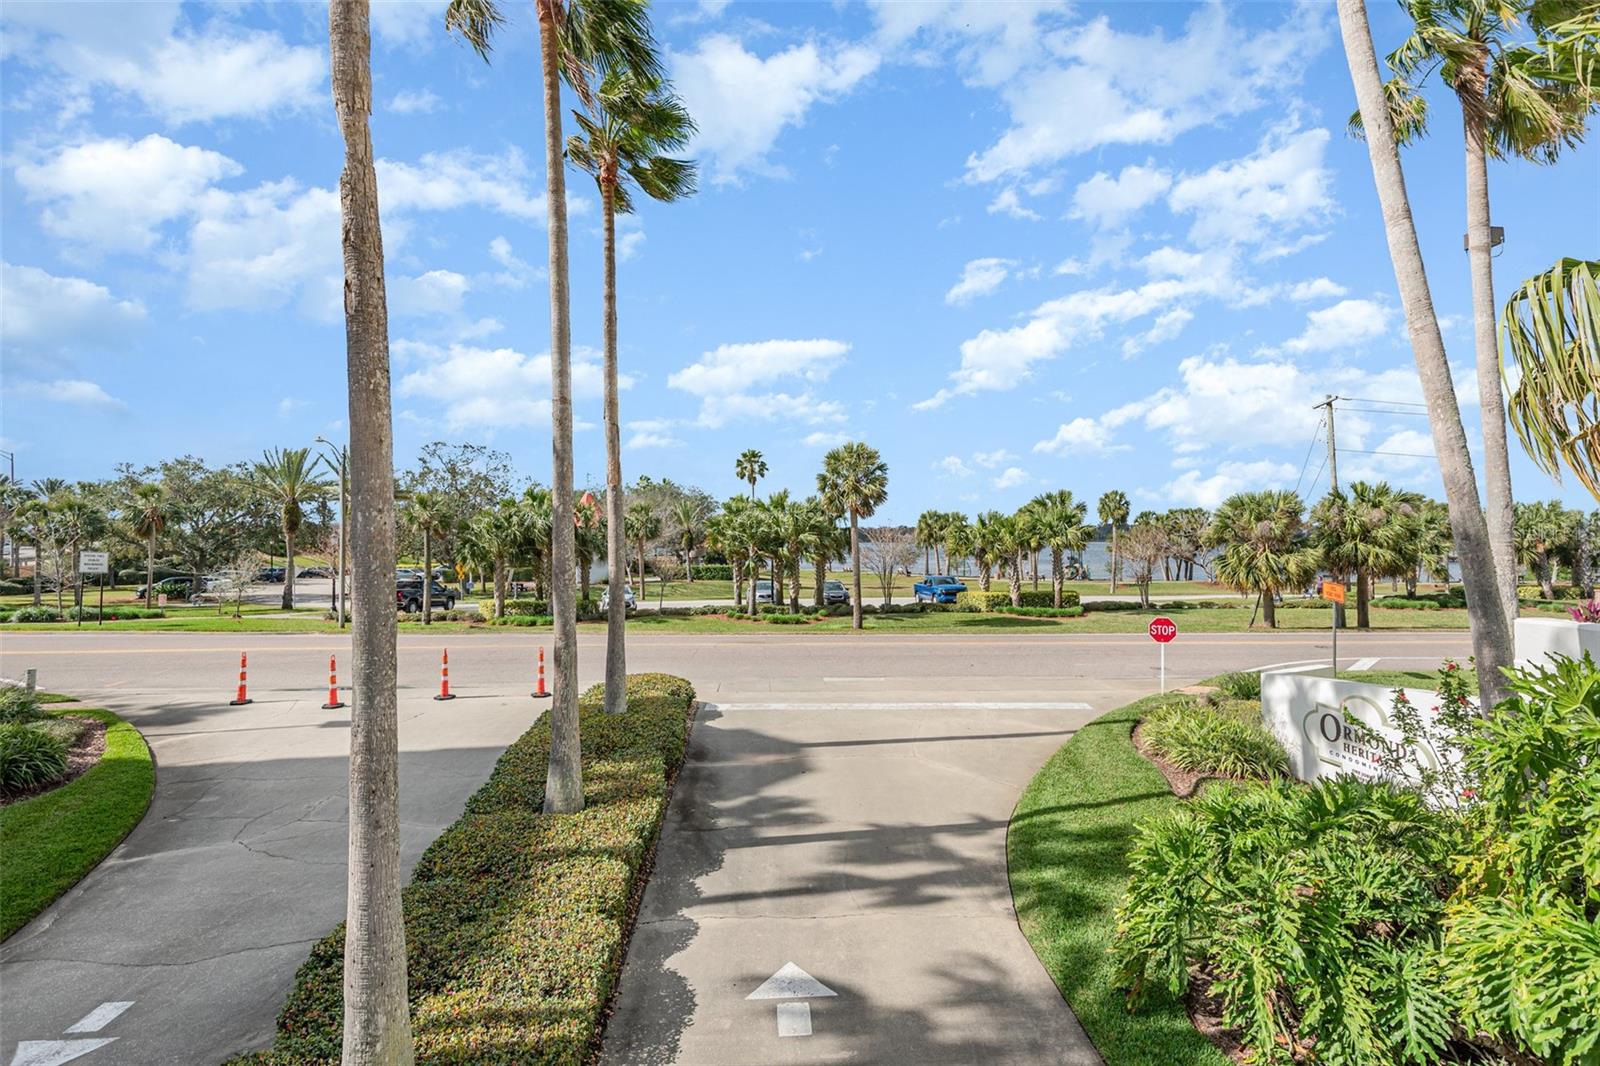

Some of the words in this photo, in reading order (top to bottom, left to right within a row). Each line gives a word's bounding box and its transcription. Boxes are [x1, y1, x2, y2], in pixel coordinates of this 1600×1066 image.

[1151, 625, 1175, 635] STOP
[1320, 713, 1407, 760] ORMOND
[1329, 750, 1389, 774] CONDOMINI
[1343, 742, 1383, 764] HERITA
